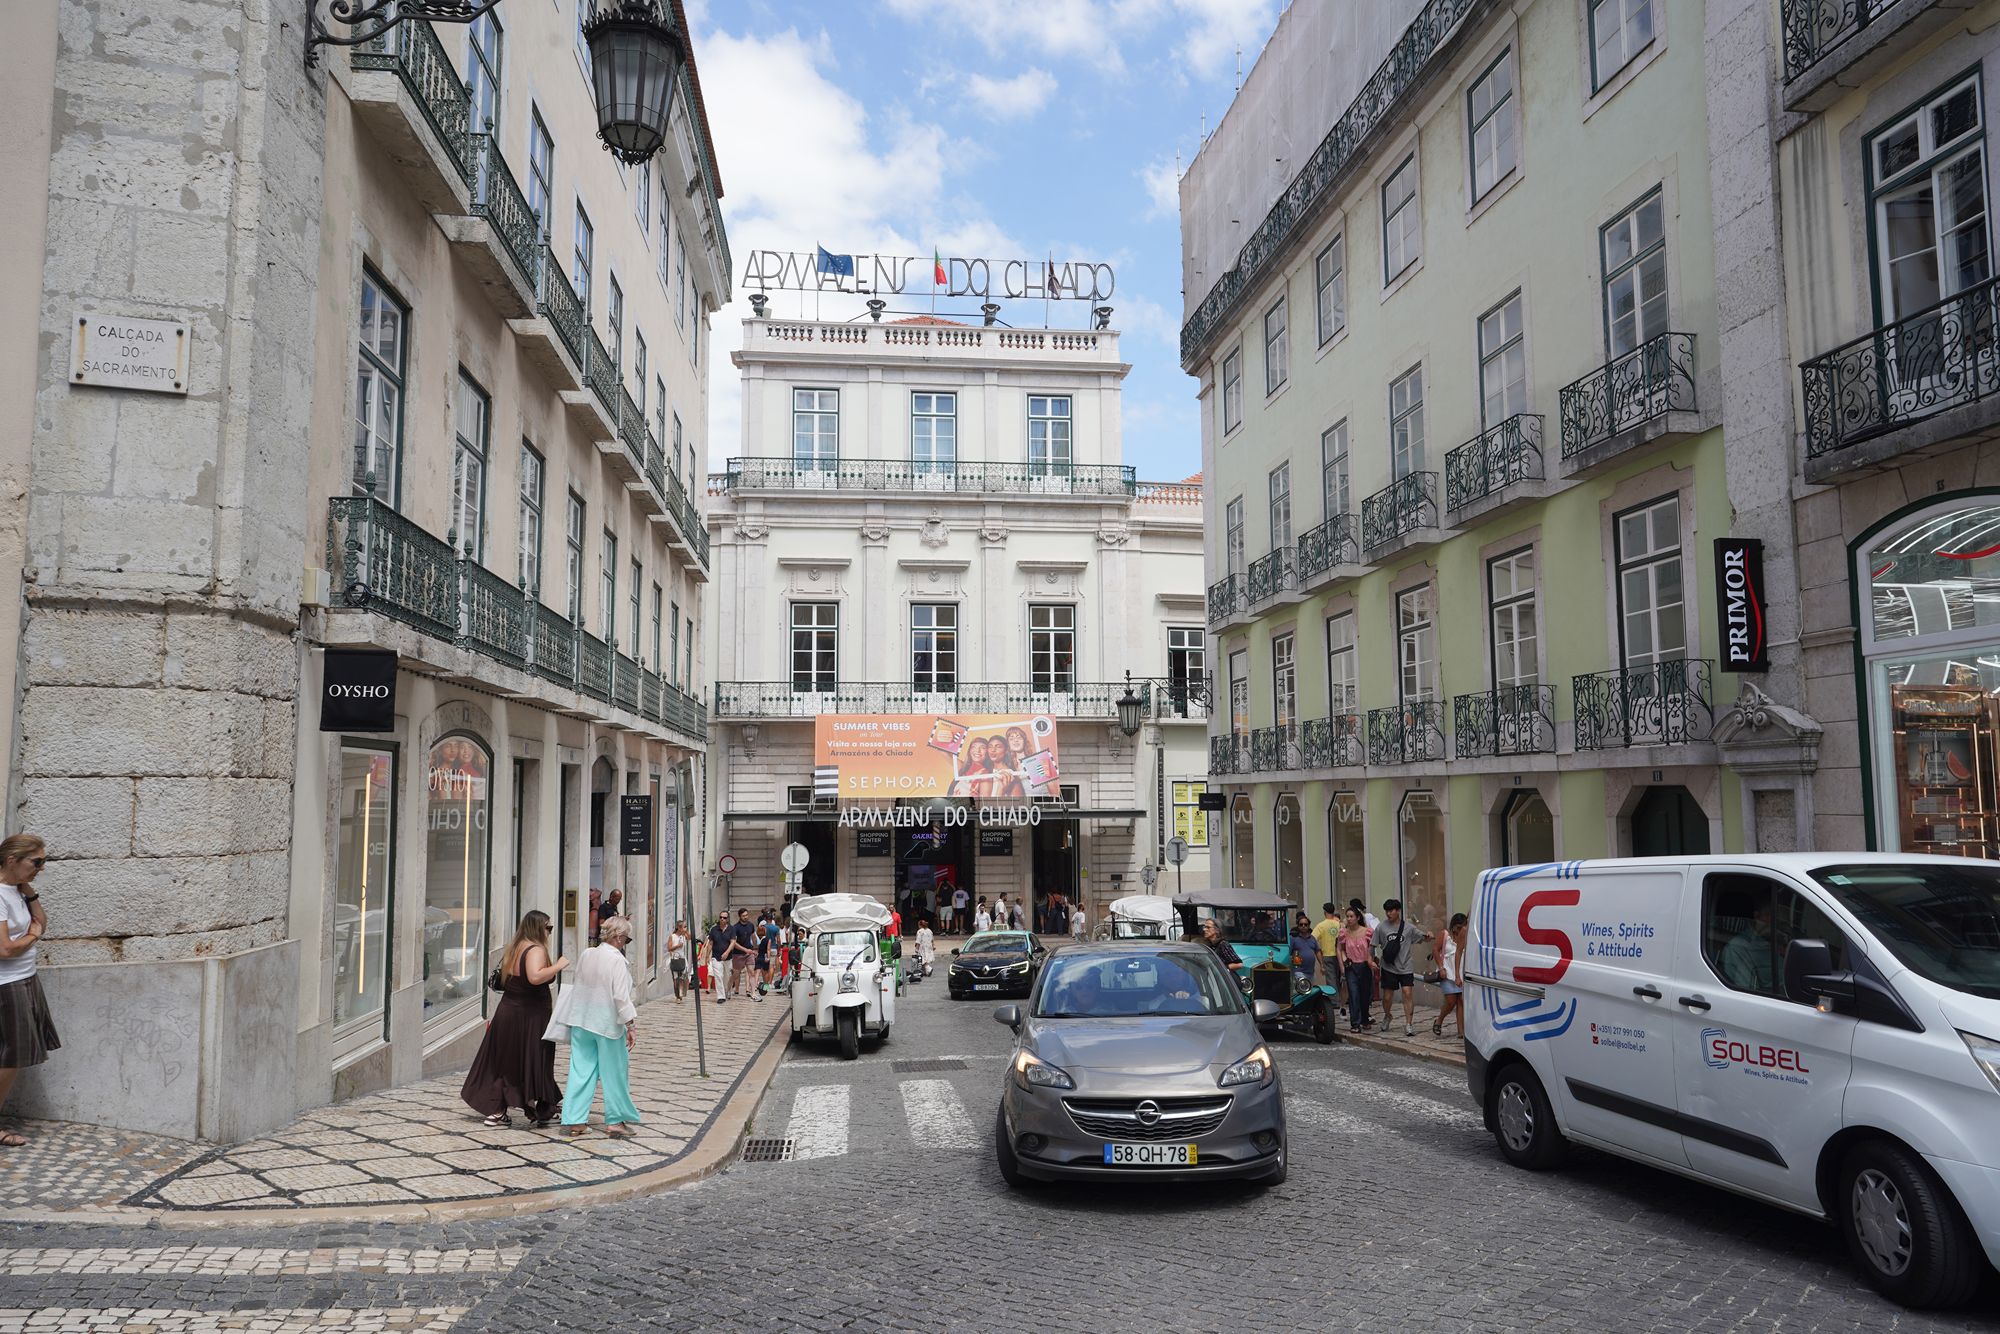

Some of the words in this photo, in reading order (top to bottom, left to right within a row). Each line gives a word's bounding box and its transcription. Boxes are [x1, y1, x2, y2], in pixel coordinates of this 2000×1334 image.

[948, 257, 990, 296] DO
[1004, 259, 1115, 301] CHADO
[98, 325, 164, 343] CALÇADA
[121, 346, 140, 358] DO
[82, 360, 177, 380] SACRAMENTO
[1724, 548, 1750, 663] PRIMOR
[328, 684, 389, 698] OYSHO
[833, 722, 879, 731] SUMMER
[882, 722, 911, 731] VIBES
[827, 740, 850, 748] Visita
[884, 740, 900, 749] loja
[872, 749, 883, 757] do
[885, 749, 914, 757] Chiado
[428, 767, 466, 792] OYSHO
[849, 776, 937, 789] SEPHORA
[838, 805, 933, 828] ARMAZENS
[944, 805, 968, 827] DO
[979, 805, 1041, 827] CHIADO
[1582, 922, 1615, 938] Wines,
[1618, 922, 1654, 940] Spirits
[1587, 942, 1595, 956] &
[1597, 942, 1643, 958] Attitude
[1612, 1026, 1622, 1035] 217
[1623, 1028, 1633, 1037] 991
[1633, 1030, 1645, 1039] 050
[1600, 1038, 1646, 1053] solbel@solbel.pt
[1712, 1039, 1809, 1073] SOLBEL
[1744, 1067, 1761, 1077] Wines,
[1762, 1070, 1779, 1081] Spirits
[1785, 1075, 1809, 1085] Attitude
